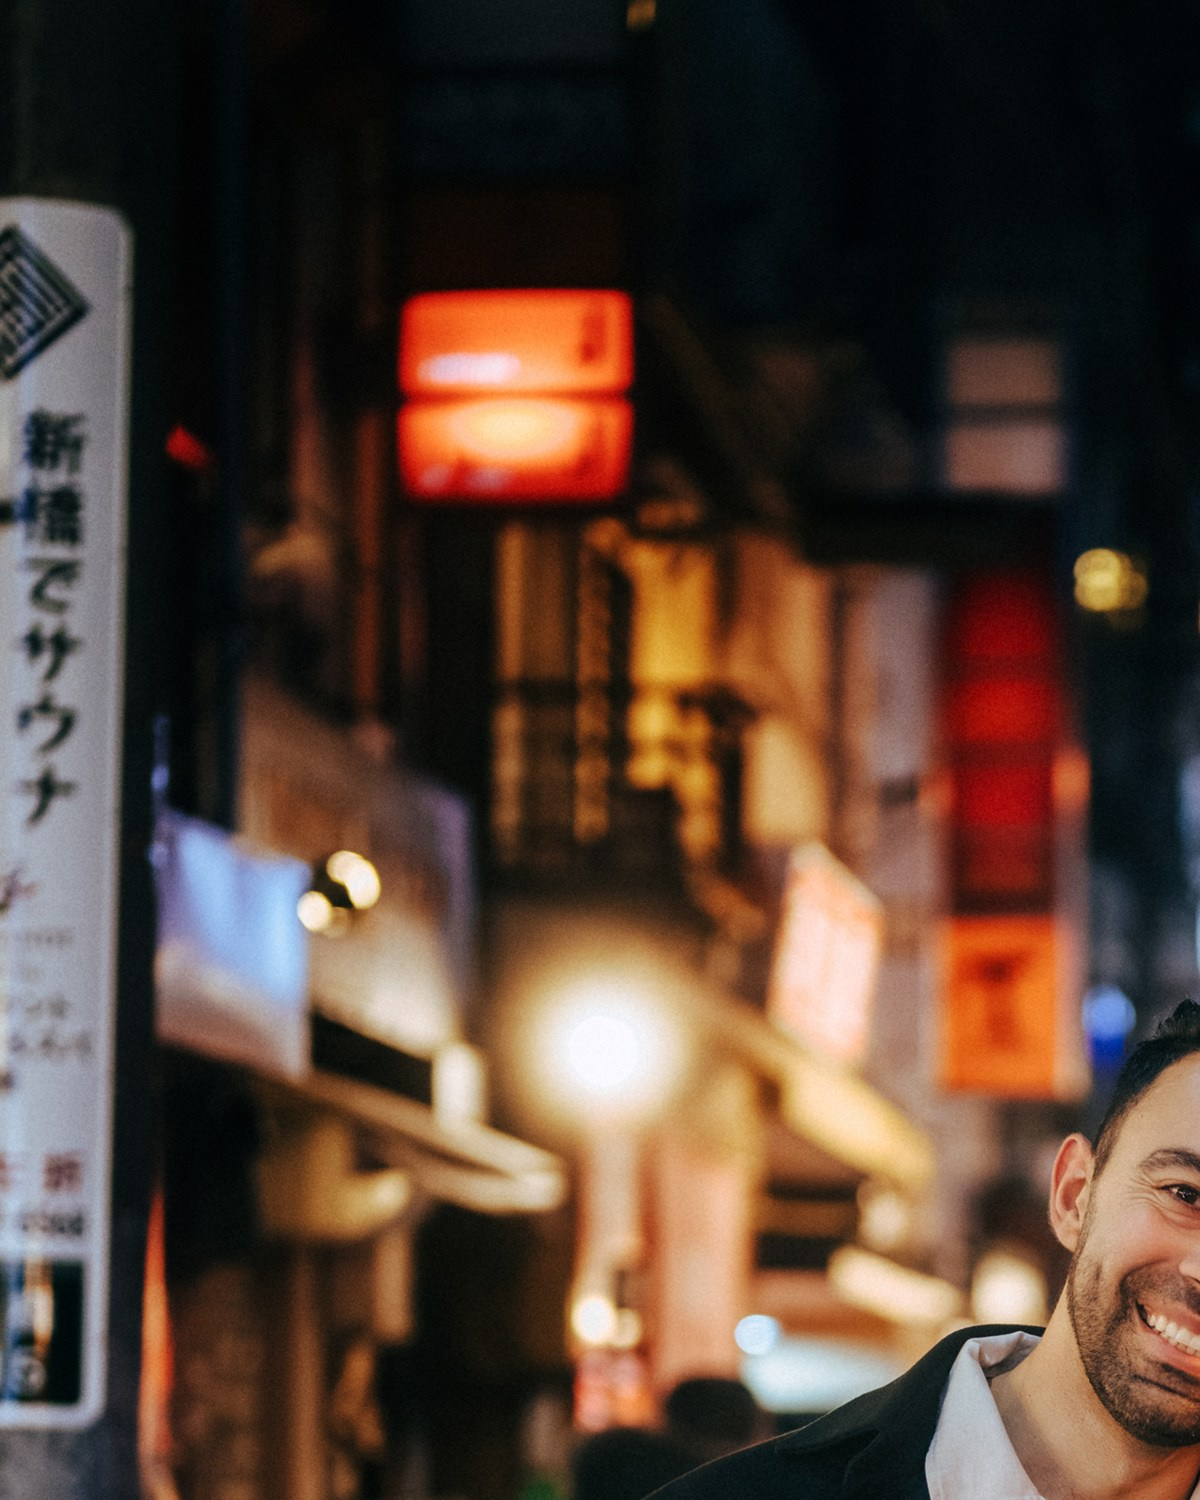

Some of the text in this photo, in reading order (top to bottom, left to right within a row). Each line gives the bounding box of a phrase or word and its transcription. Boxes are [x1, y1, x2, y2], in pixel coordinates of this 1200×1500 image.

[18, 409, 87, 829] 新橋でサウナ
